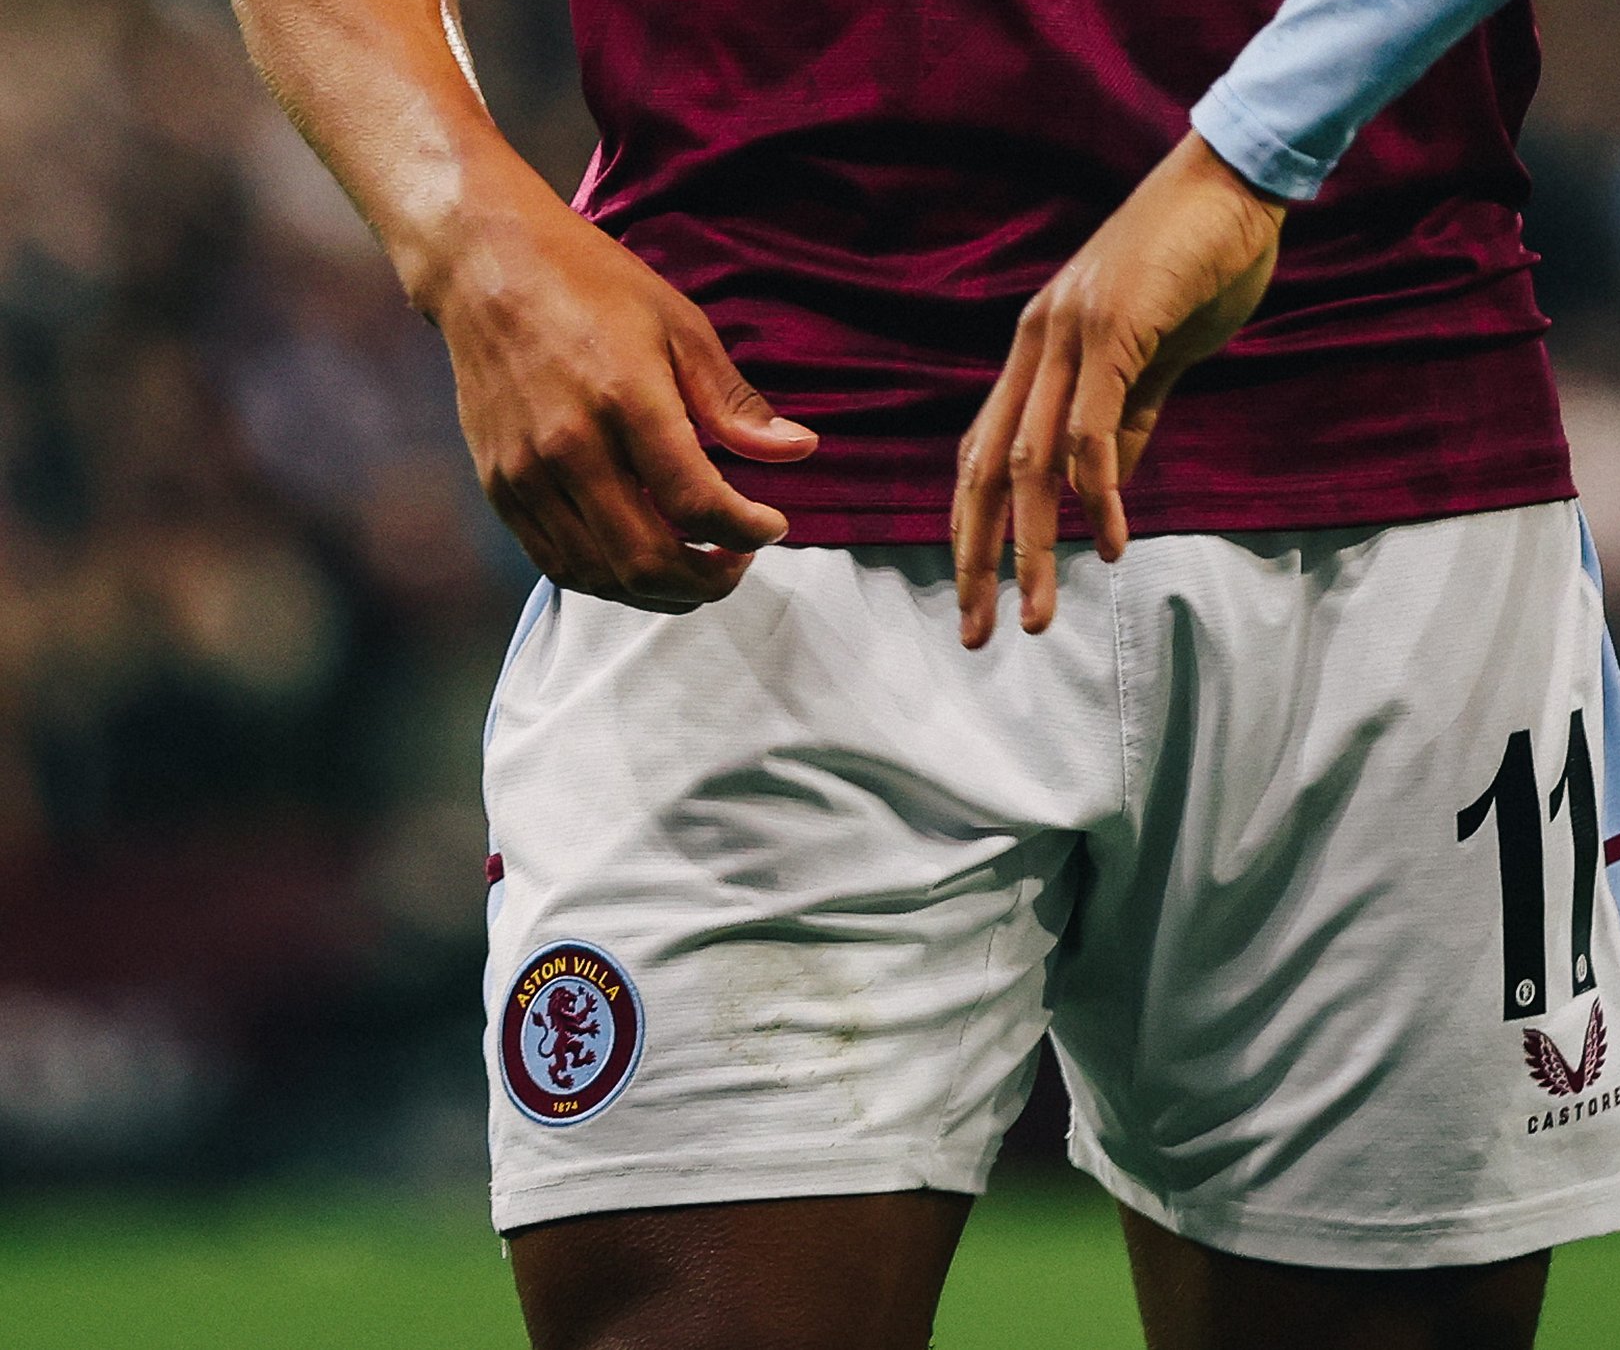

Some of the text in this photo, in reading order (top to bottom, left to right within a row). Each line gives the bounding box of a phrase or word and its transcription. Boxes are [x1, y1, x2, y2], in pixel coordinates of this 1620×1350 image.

[1457, 707, 1599, 1021] 11
[517, 956, 620, 1008] ASTON VILLA
